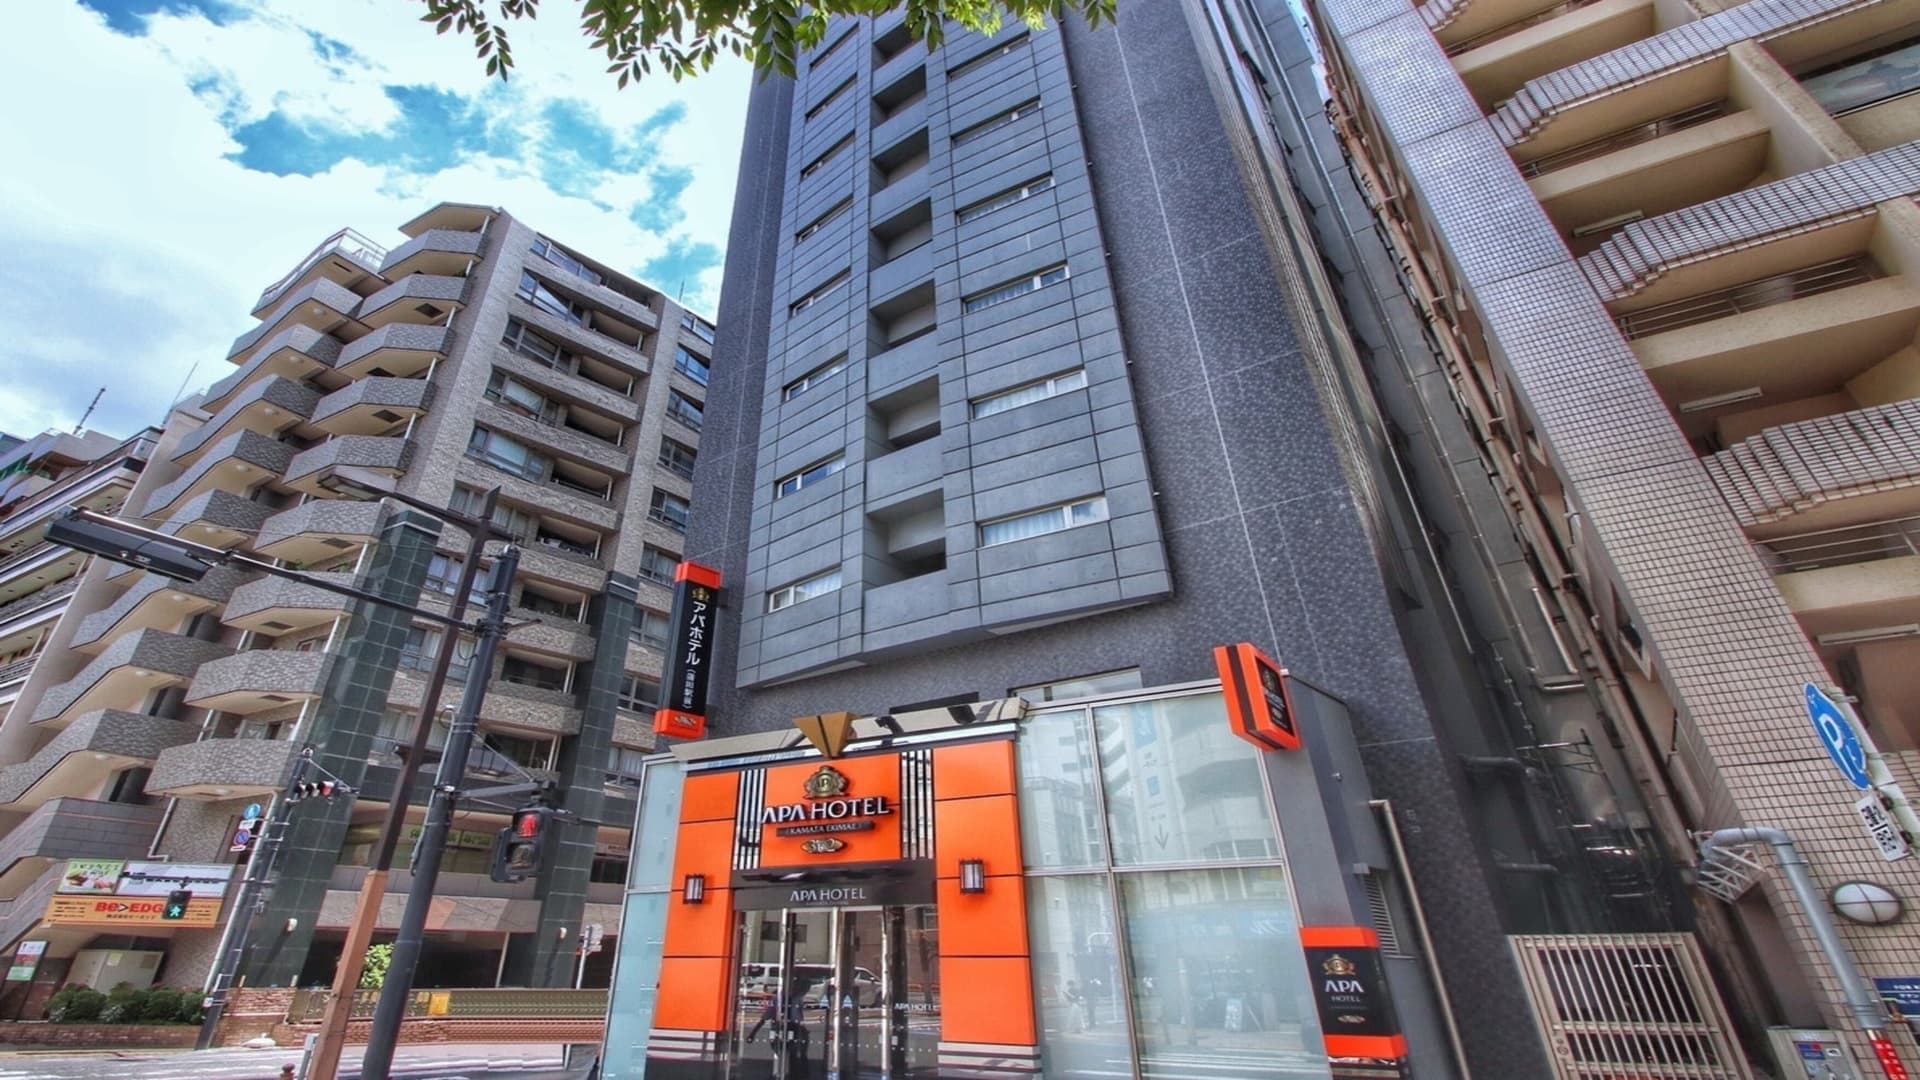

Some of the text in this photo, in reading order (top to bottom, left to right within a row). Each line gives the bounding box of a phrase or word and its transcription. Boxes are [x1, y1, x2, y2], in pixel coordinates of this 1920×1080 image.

[1818, 713, 1857, 781] P
[762, 796, 890, 824] APA HOTEL
[790, 887, 867, 902] APA HOTEL
[1325, 980, 1365, 992] APA
